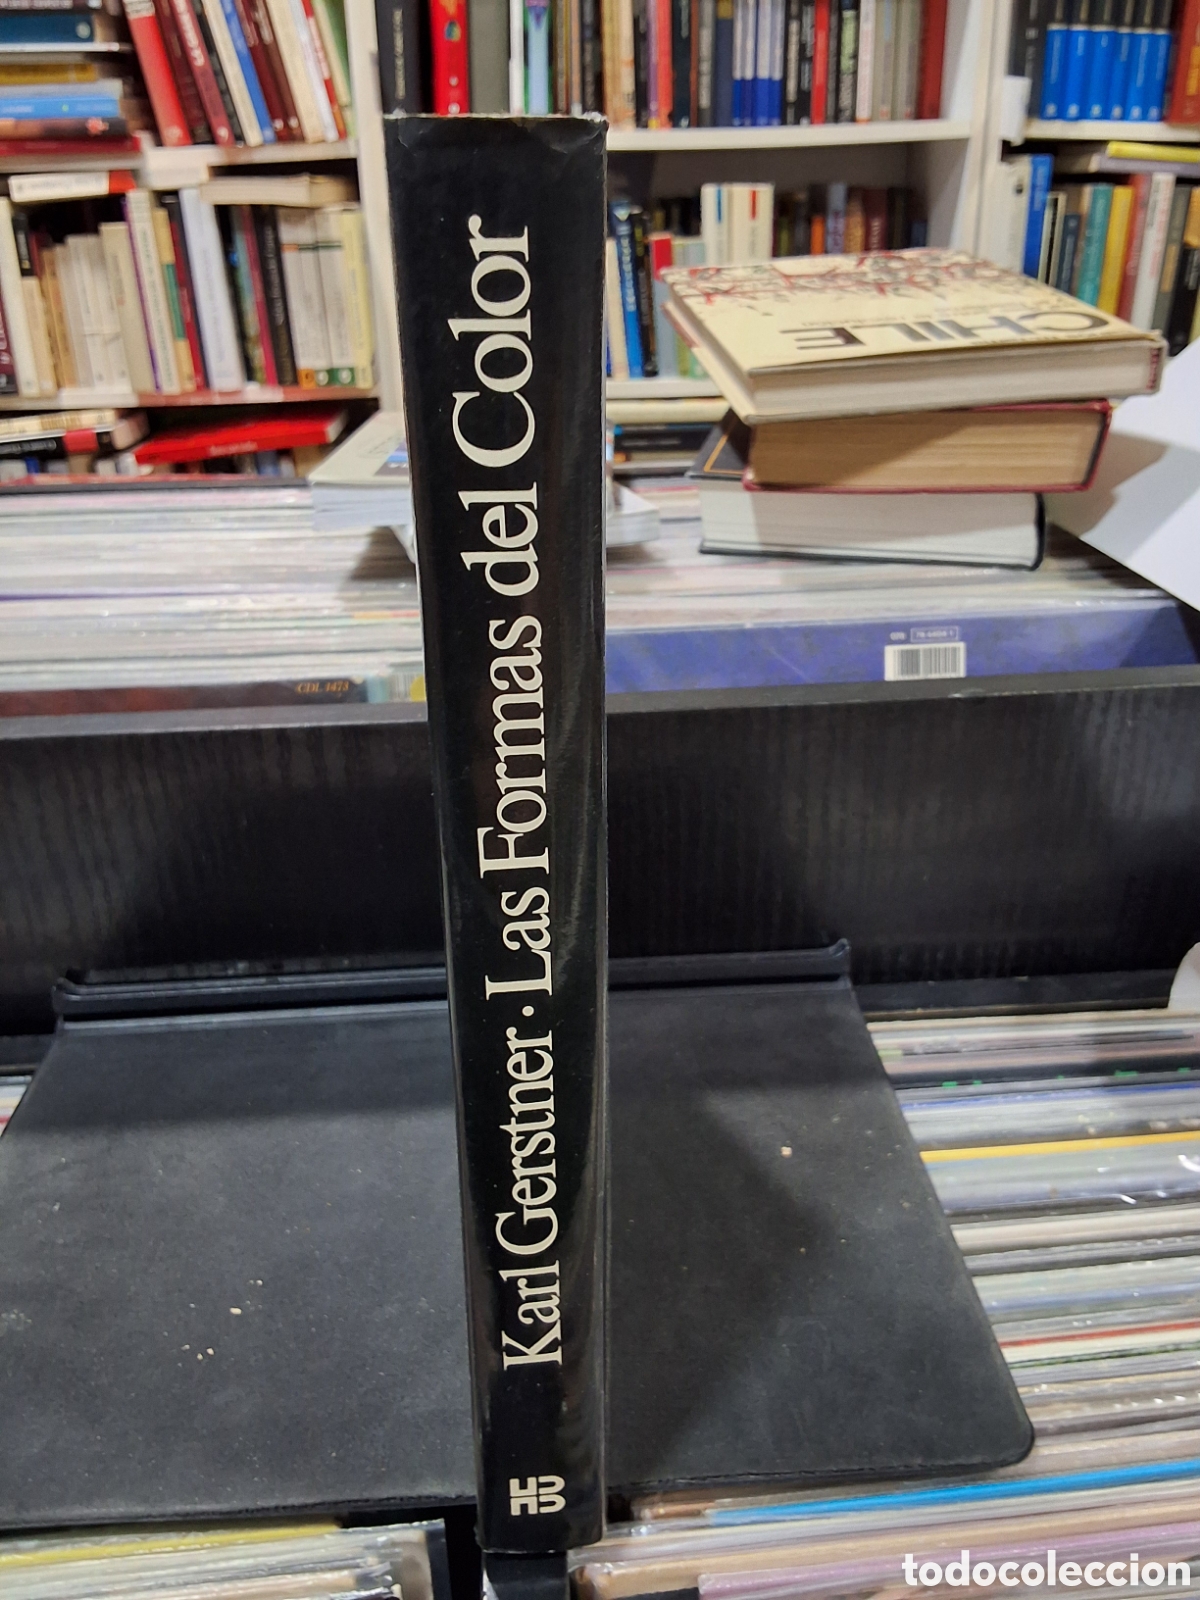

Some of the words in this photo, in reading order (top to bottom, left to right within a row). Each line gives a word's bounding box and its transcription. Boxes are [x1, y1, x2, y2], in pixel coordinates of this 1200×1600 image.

[447, 214, 535, 468] Color
[779, 311, 1110, 351] CHILE
[458, 482, 539, 597] del
[477, 615, 550, 879] Formas
[484, 886, 553, 1001] Las
[495, 1026, 559, 1255] Gerstner
[498, 1260, 562, 1370] Karl
